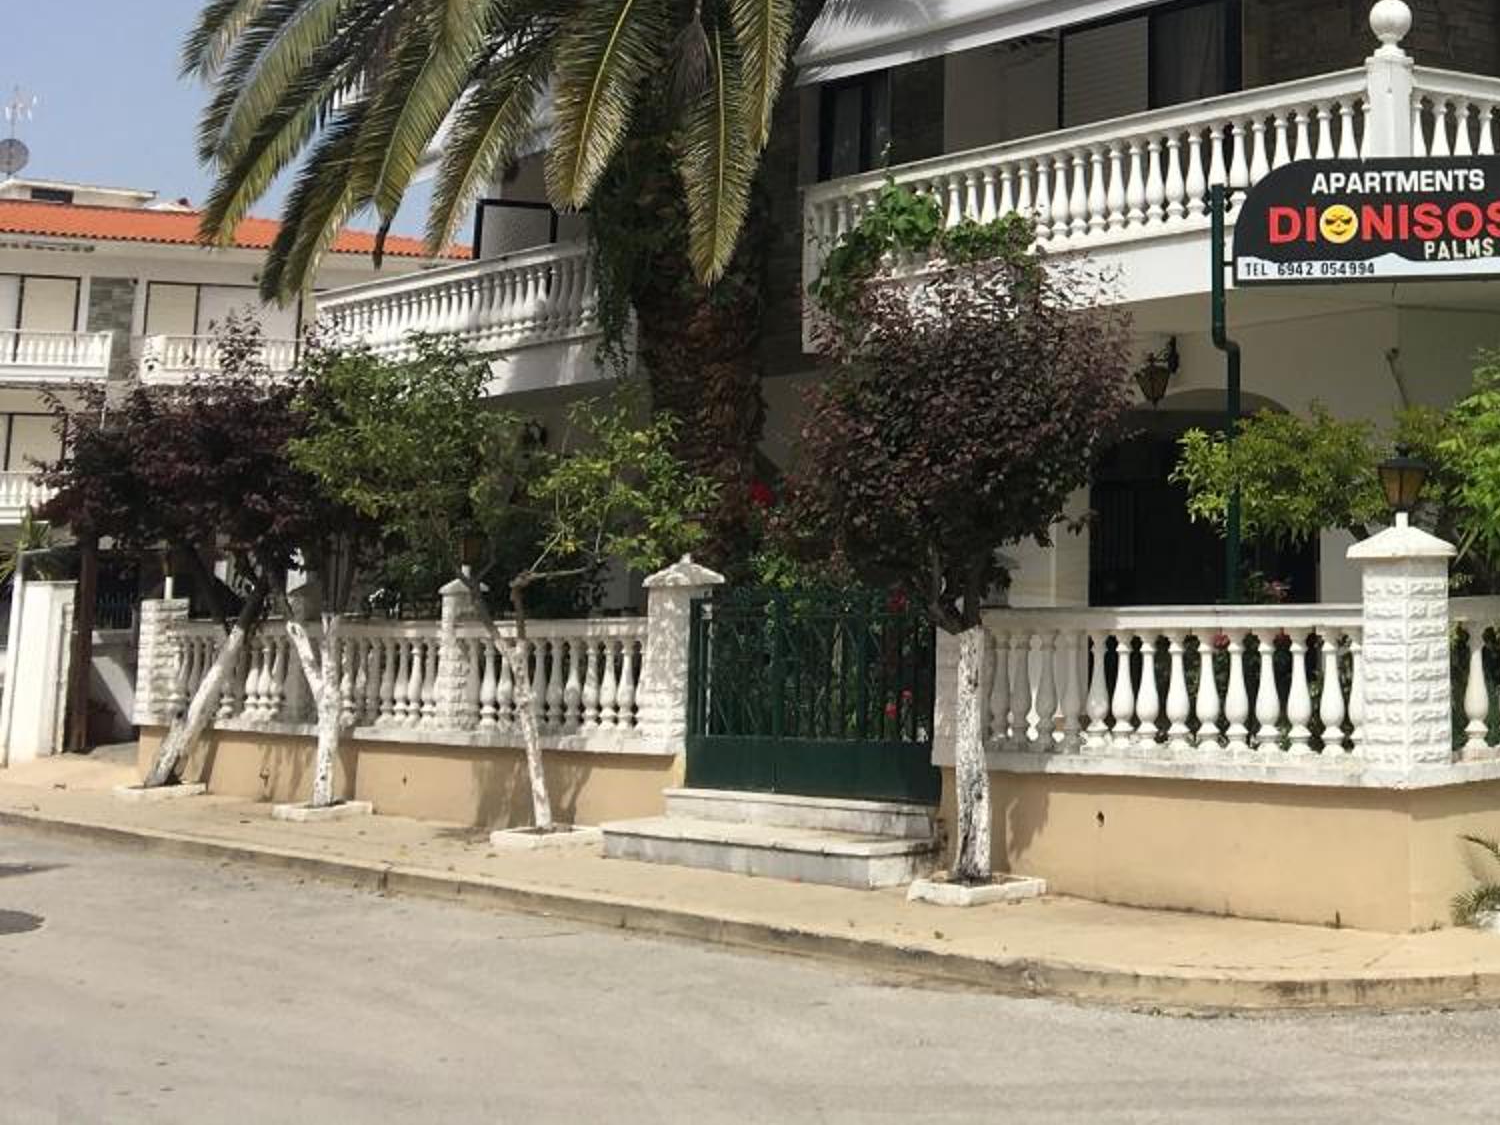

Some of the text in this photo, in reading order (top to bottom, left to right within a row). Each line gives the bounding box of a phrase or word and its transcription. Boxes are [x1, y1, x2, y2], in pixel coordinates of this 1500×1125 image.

[1311, 169, 1485, 195] APARTMENTS
[1424, 238, 1495, 261] PALMS
[1244, 262, 1269, 277] TEL
[1277, 261, 1314, 276] 6942
